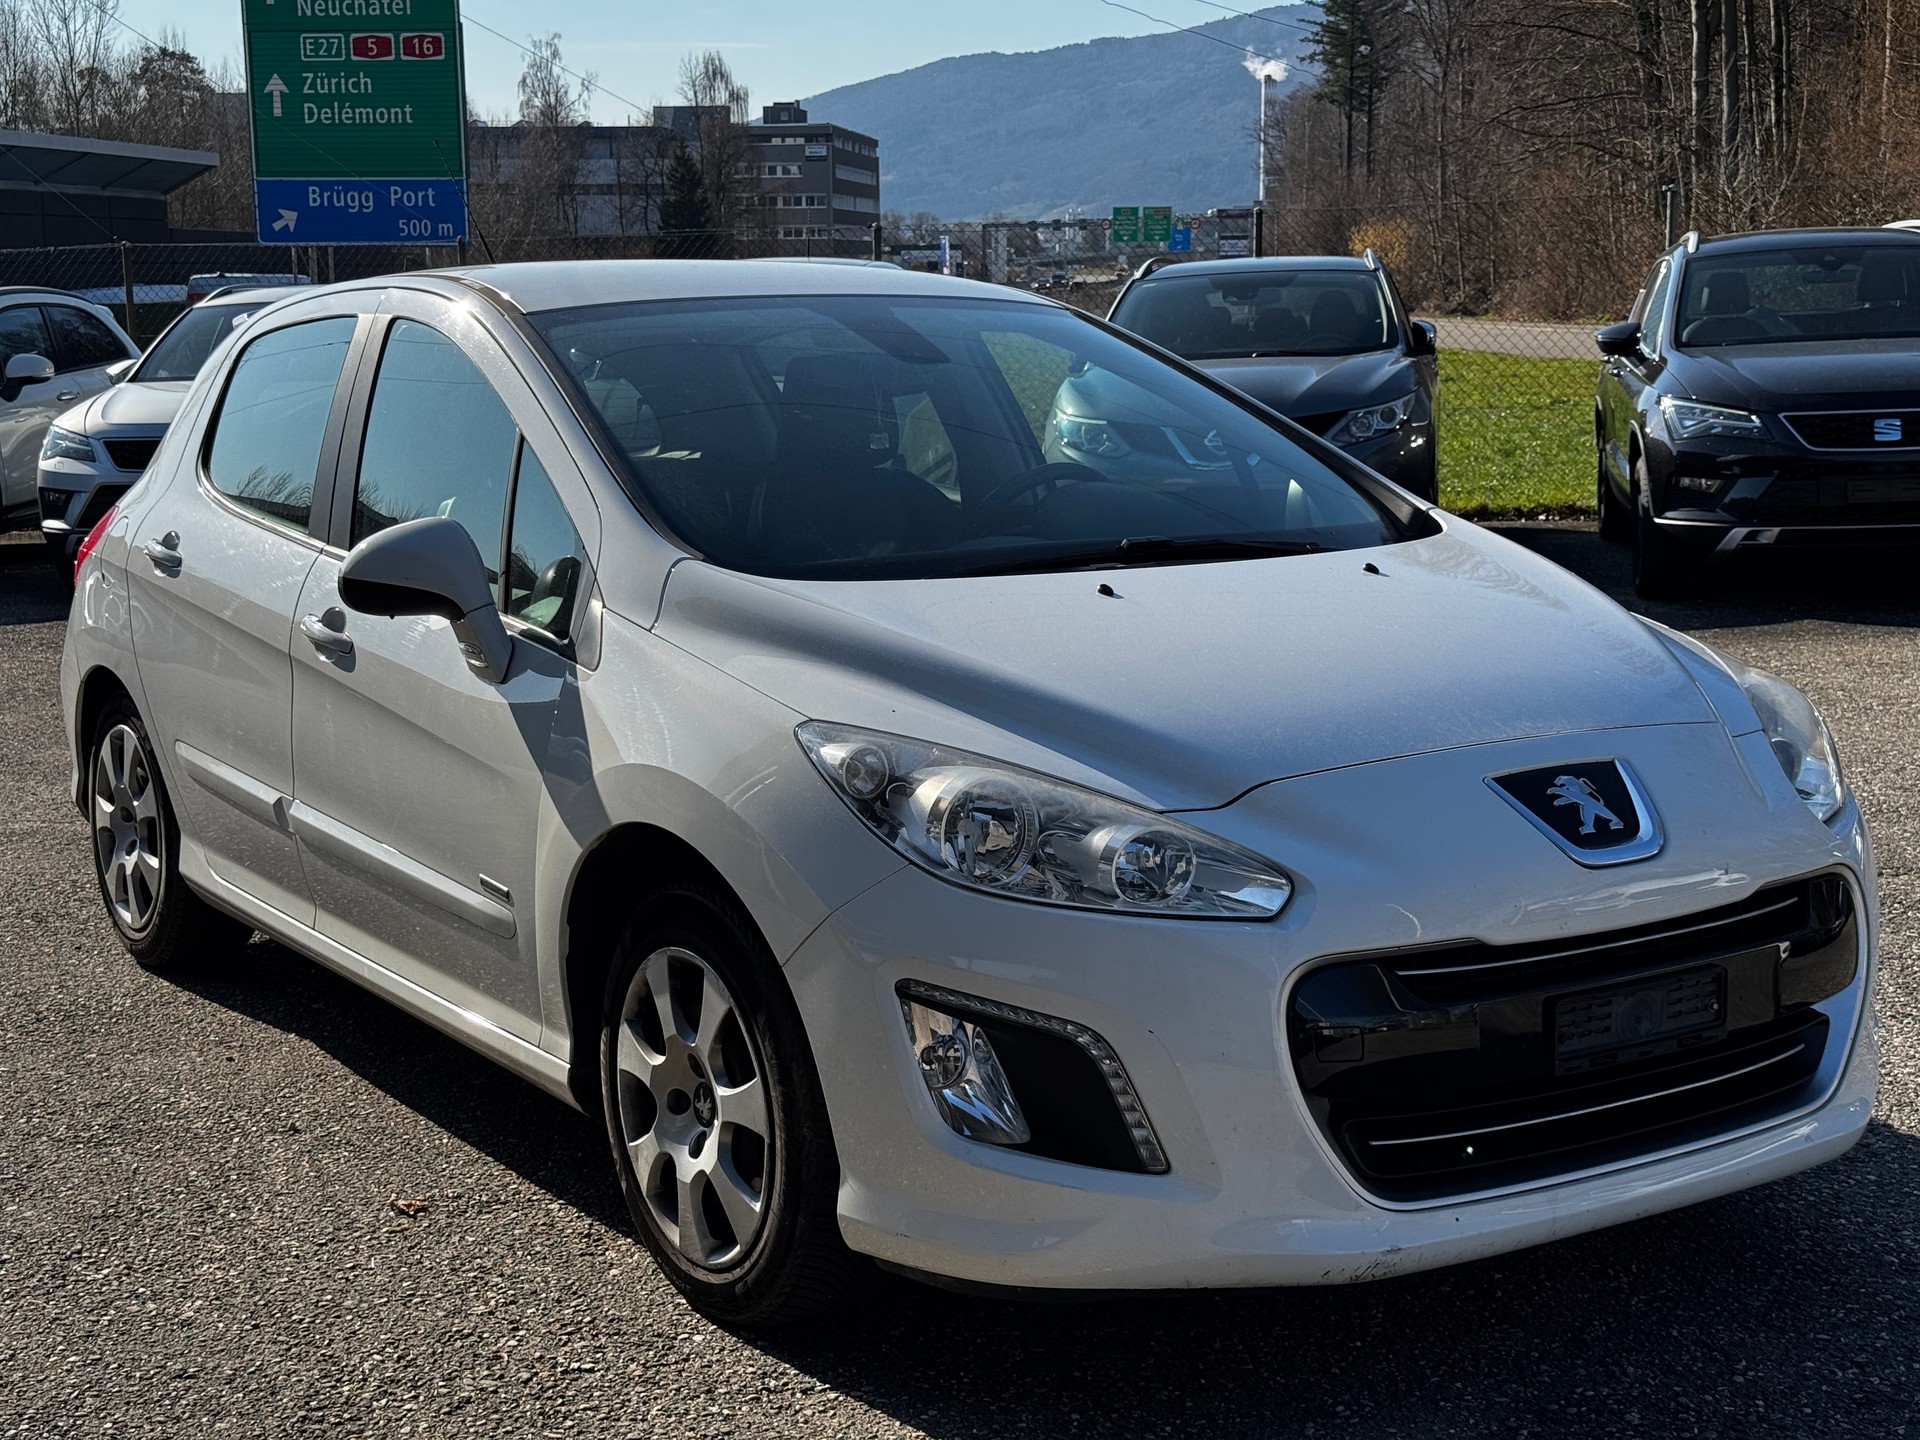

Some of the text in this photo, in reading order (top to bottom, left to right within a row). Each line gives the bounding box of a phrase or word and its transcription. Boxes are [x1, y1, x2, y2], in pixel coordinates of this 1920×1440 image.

[367, 38, 378, 56] 5
[412, 37, 434, 55] 16
[302, 71, 373, 94] Zürich
[303, 101, 413, 124] Delémont
[308, 186, 436, 213] Brügg Port
[399, 219, 454, 237] 500 m
